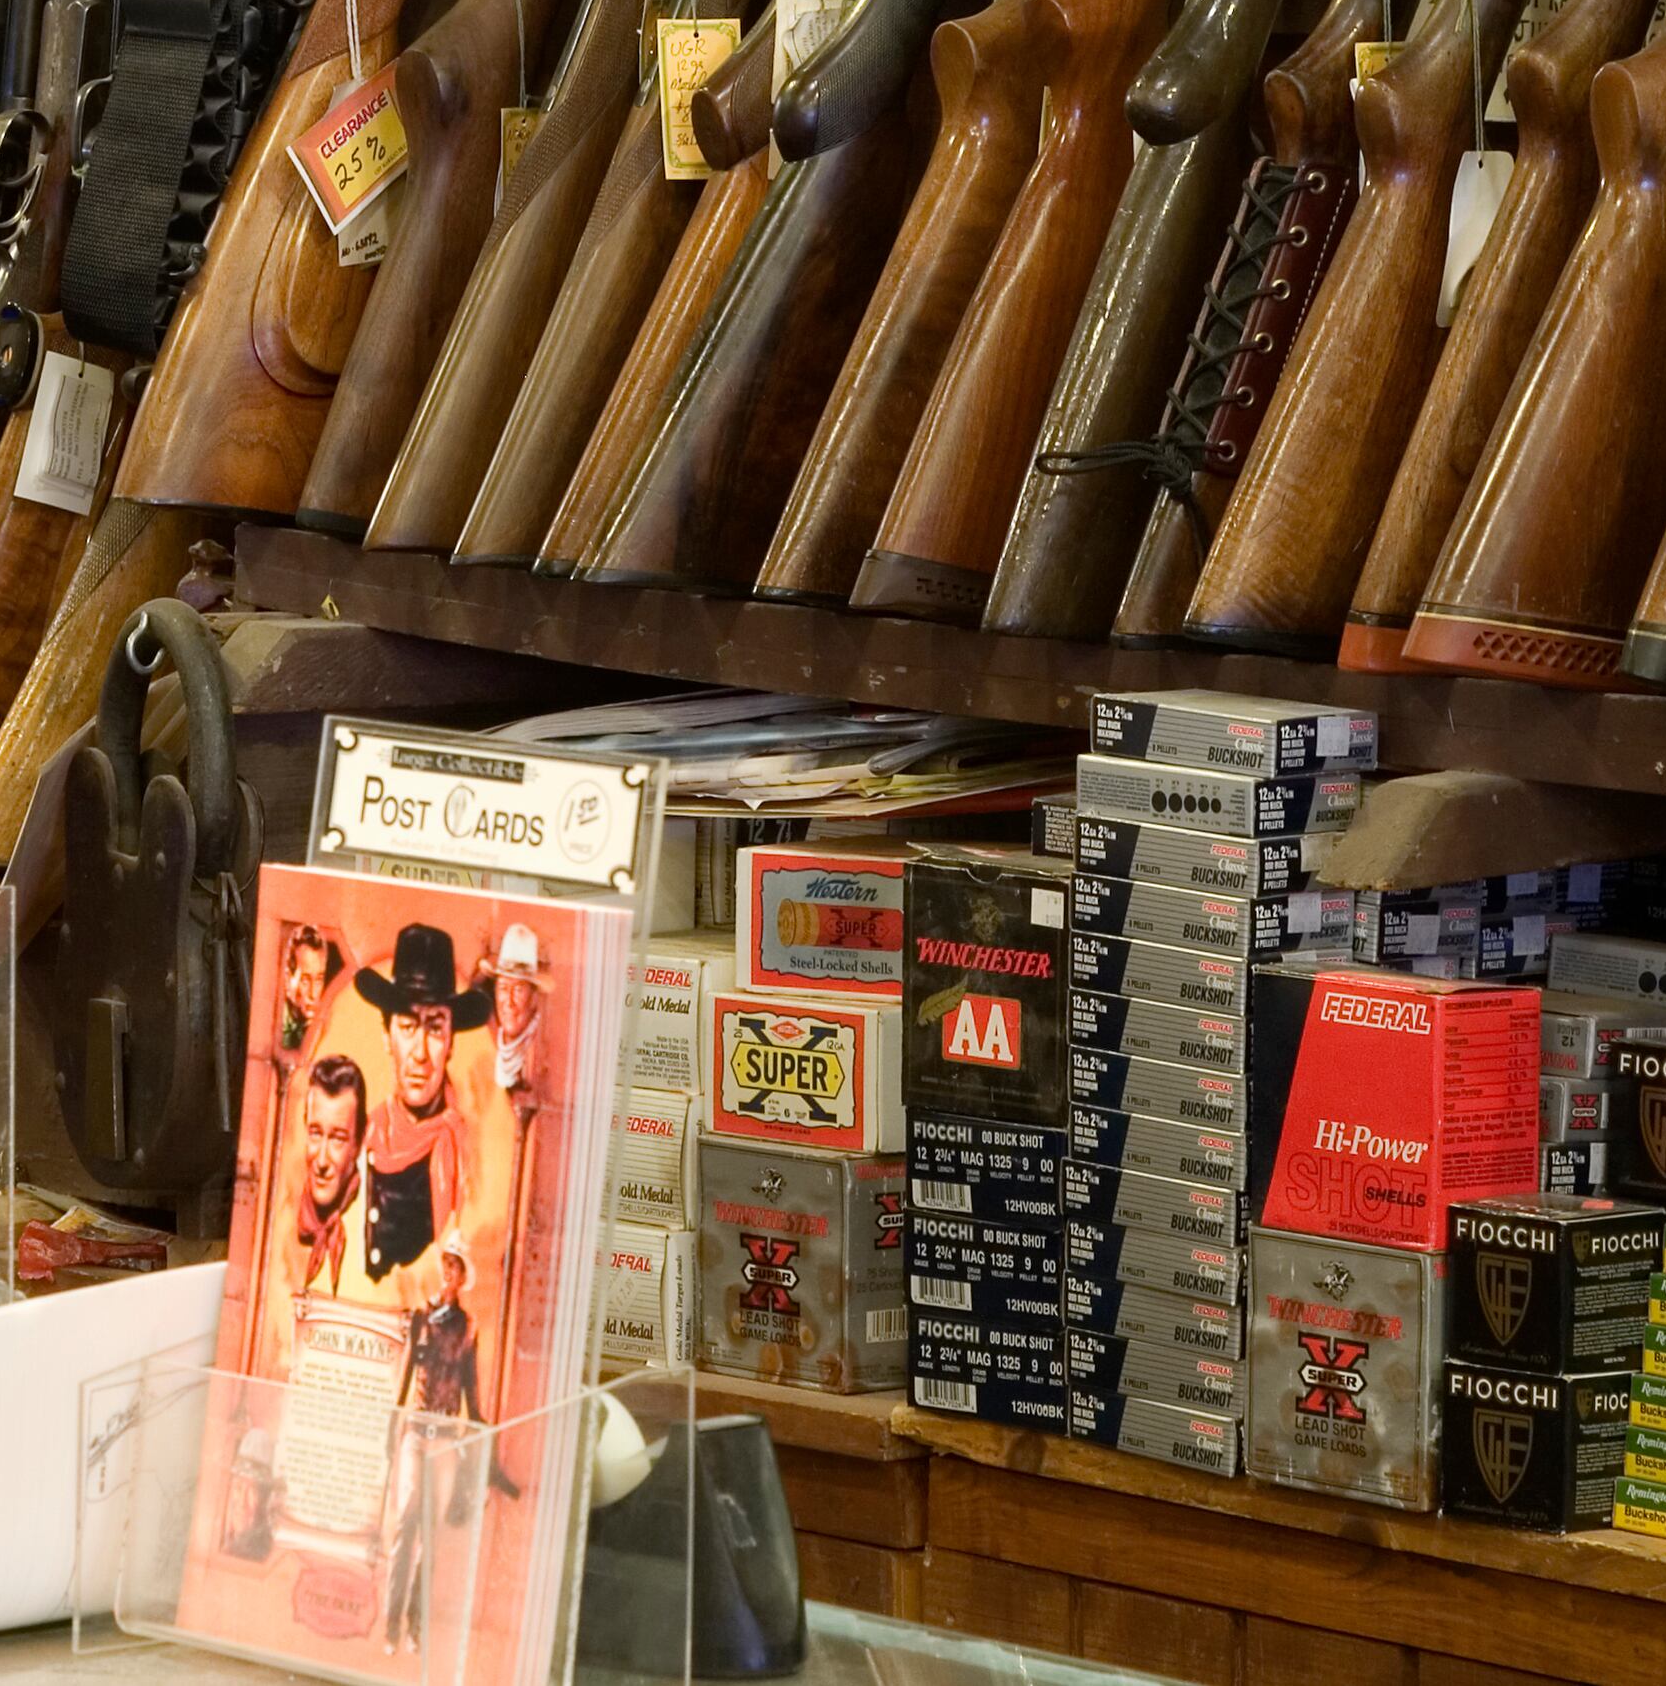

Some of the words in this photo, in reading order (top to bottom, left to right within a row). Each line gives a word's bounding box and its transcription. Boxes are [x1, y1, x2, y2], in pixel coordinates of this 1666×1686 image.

[321, 92, 389, 159] CLEARANCE
[1227, 724, 1265, 739] FEDERAL
[1234, 737, 1266, 754] Classic
[392, 748, 433, 767] Large
[436, 753, 524, 781] Collectible
[1206, 746, 1265, 769] BUCKSHOT
[1210, 844, 1247, 859] FEDERAL
[1217, 857, 1248, 873] Classic
[805, 877, 878, 902] Western
[1190, 866, 1247, 890] BUCKSHOT
[835, 919, 876, 937] SUPER
[1209, 914, 1239, 930] Classic
[1182, 922, 1238, 947] BUCKSHOT
[789, 955, 858, 974] Steel-Locked
[860, 962, 894, 975] Shells
[916, 936, 1052, 979] WINCHESTER
[1206, 975, 1235, 989] Classic
[656, 997, 692, 1015] Medal
[1180, 982, 1235, 1007] BUCKSHOT
[1320, 991, 1432, 1035] FEDERAL
[947, 998, 1014, 1063] AA
[1179, 1041, 1234, 1065] BUCKSHOT
[745, 1046, 829, 1093] SUPER
[783, 1107, 791, 1119] 6
[982, 1130, 992, 1144] 00
[994, 1131, 1018, 1147] BUCK
[1019, 1134, 1044, 1148] SHOT
[1312, 1118, 1430, 1164] Hi-Power
[916, 1147, 928, 1160] 12
[960, 1151, 984, 1166] MAG
[988, 1154, 1013, 1169] 1325
[1021, 1157, 1030, 1171] 9
[1040, 1158, 1054, 1173] 00
[640, 1184, 674, 1205] Medal
[1285, 1150, 1429, 1230] SHOT
[1364, 1185, 1427, 1208] SHELLS
[713, 1199, 830, 1238] WINCHESTER
[1004, 1199, 1057, 1216] 12HV00BK
[995, 1231, 1020, 1247] BUCK
[1021, 1233, 1047, 1249] SHOT
[1455, 1218, 1555, 1253] FIOCCHI
[1591, 1231, 1660, 1255] FIOCCHI
[915, 1242, 928, 1257] 12
[961, 1248, 986, 1264] MAG
[990, 1252, 1014, 1268] 1325
[1024, 1257, 1032, 1271] 9
[1042, 1259, 1057, 1274] 00
[749, 1266, 793, 1284] SUPER
[1005, 1298, 1059, 1316] 12HV00BK
[1266, 1293, 1404, 1341] WINCHESTER
[619, 1321, 654, 1340] Medal
[739, 1310, 770, 1327] LEAD
[771, 1314, 801, 1331] SHOT
[304, 1326, 341, 1351] JOHN
[345, 1332, 395, 1362] WAYNE
[739, 1325, 769, 1343] GAME
[769, 1329, 802, 1347] LOADS
[1002, 1331, 1027, 1348] BUCK
[1028, 1334, 1054, 1351] SHOT
[919, 1344, 932, 1358] 12
[966, 1349, 992, 1366] MAG
[996, 1354, 1021, 1371] 1325
[1031, 1358, 1039, 1373] 9
[1049, 1361, 1063, 1376] 00
[1307, 1367, 1359, 1389] SUPER
[1450, 1375, 1558, 1410] FIOCCHI
[1011, 1400, 1065, 1419] 12HV00BK
[1294, 1414, 1329, 1434] LEAD
[1332, 1419, 1367, 1442] SHOT
[1294, 1433, 1329, 1451] GAME
[1330, 1436, 1367, 1458] LOADS
